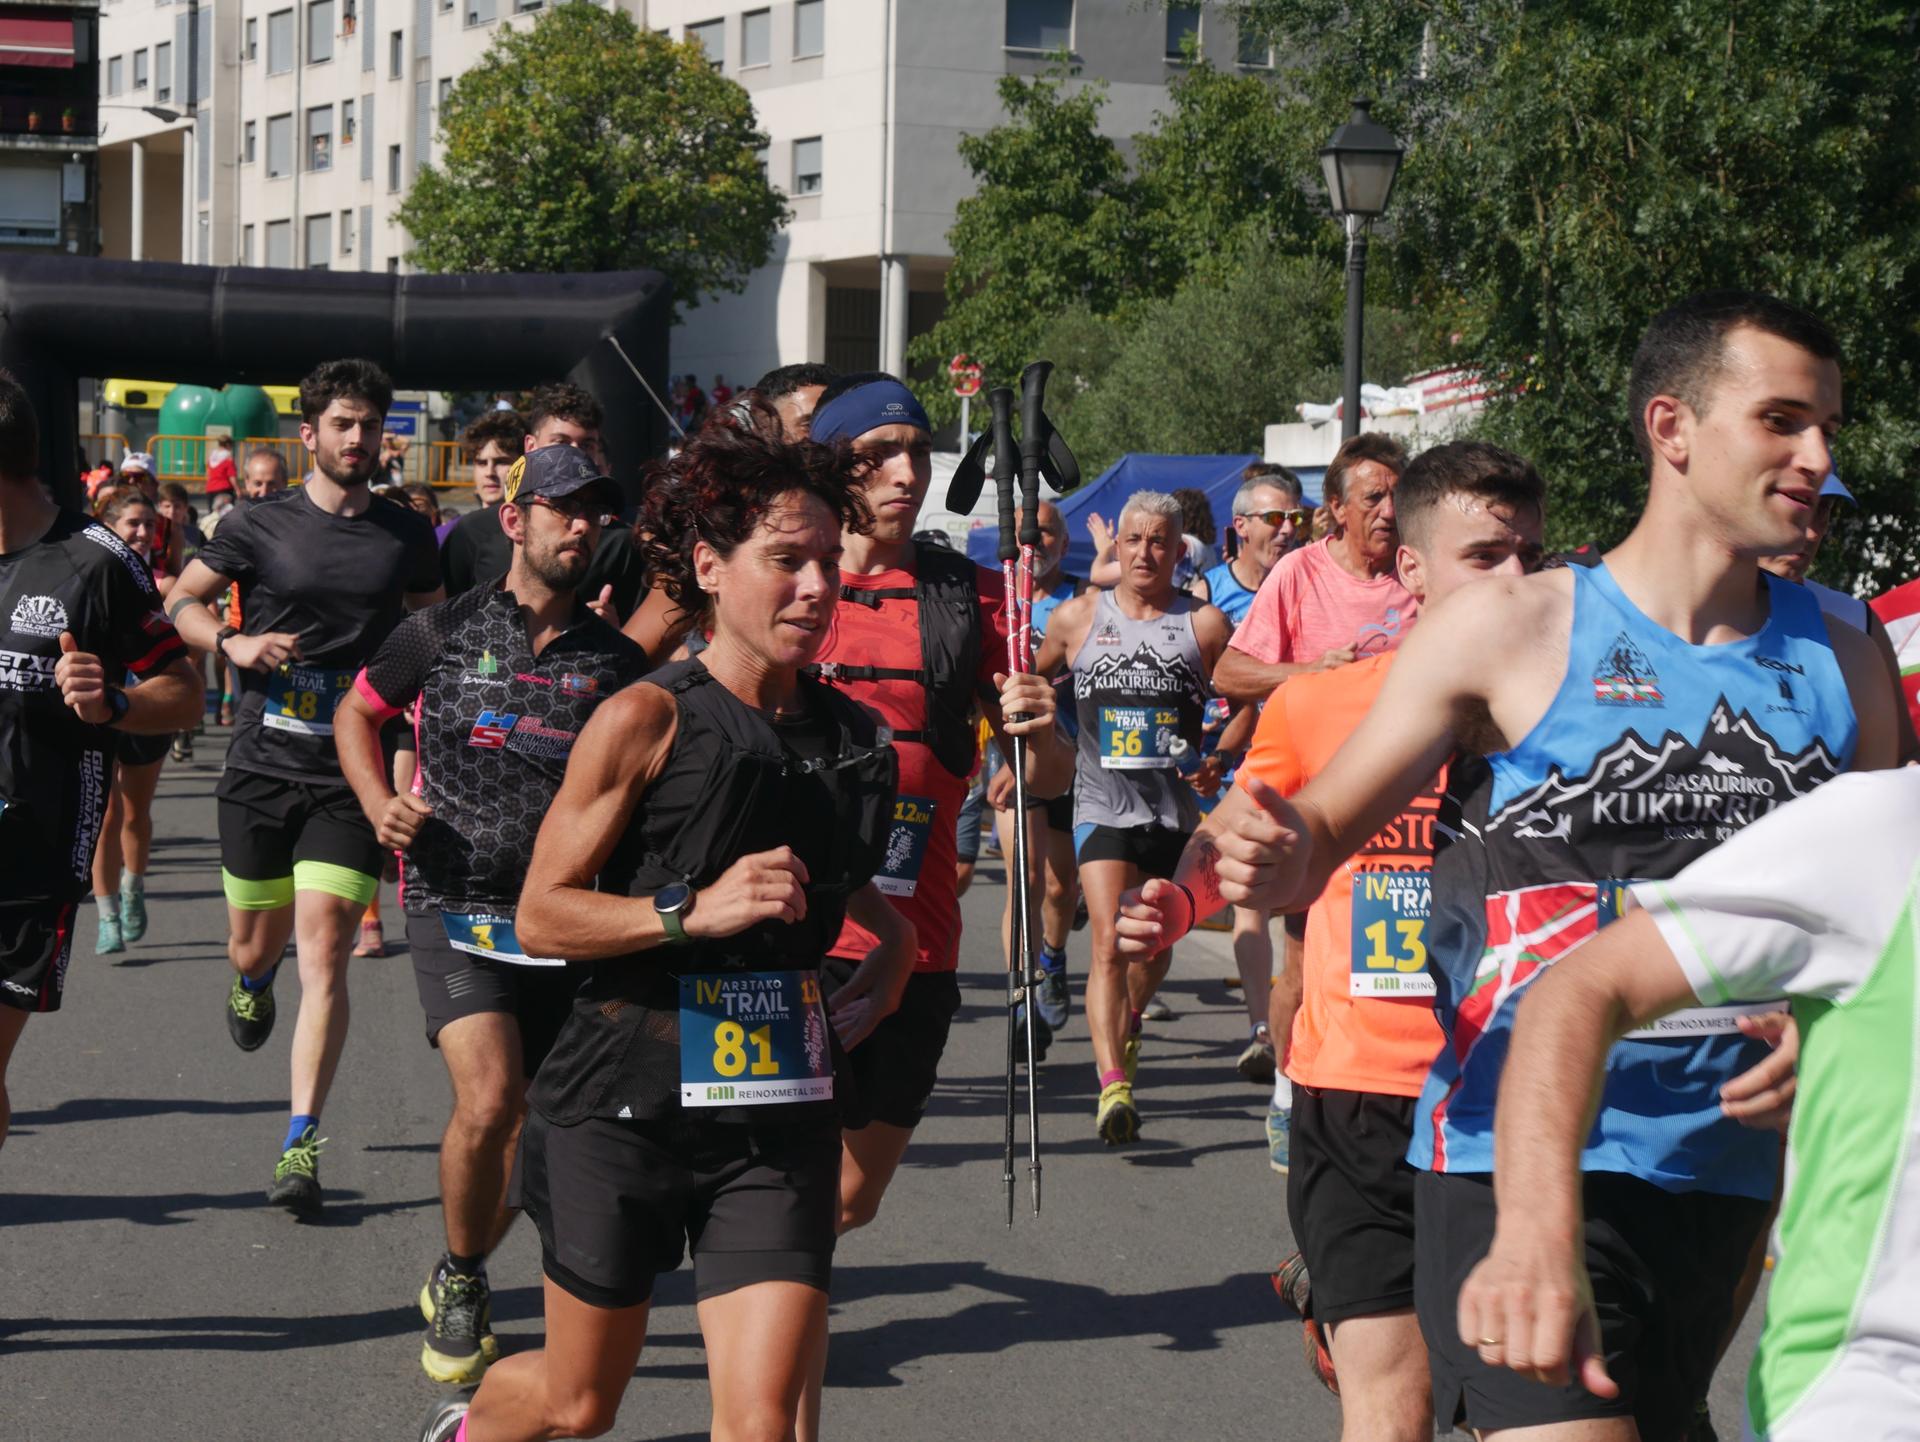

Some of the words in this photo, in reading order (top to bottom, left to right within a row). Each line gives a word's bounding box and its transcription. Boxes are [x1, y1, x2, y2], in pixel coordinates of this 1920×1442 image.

[291, 674, 327, 691] TRAIL
[1094, 675, 1183, 692] KUKURRUSTU
[281, 690, 319, 720] 18
[1115, 716, 1149, 728] TRAIL
[506, 741, 569, 760] SALVADOR
[510, 731, 572, 750] HERMANOS
[1111, 730, 1142, 757] 56
[1663, 773, 1776, 797] BASAURIKO
[1592, 789, 1778, 825] KUKURRU
[1388, 877, 1431, 888] ARETA
[1388, 888, 1432, 912] TRA
[471, 924, 496, 951] 3
[1364, 918, 1428, 973] 13
[721, 991, 790, 1016] TRAIL
[1660, 1017, 1738, 1032] REINOXMETA
[712, 1020, 780, 1078] 81
[738, 1088, 808, 1099] REINOXMETAL
